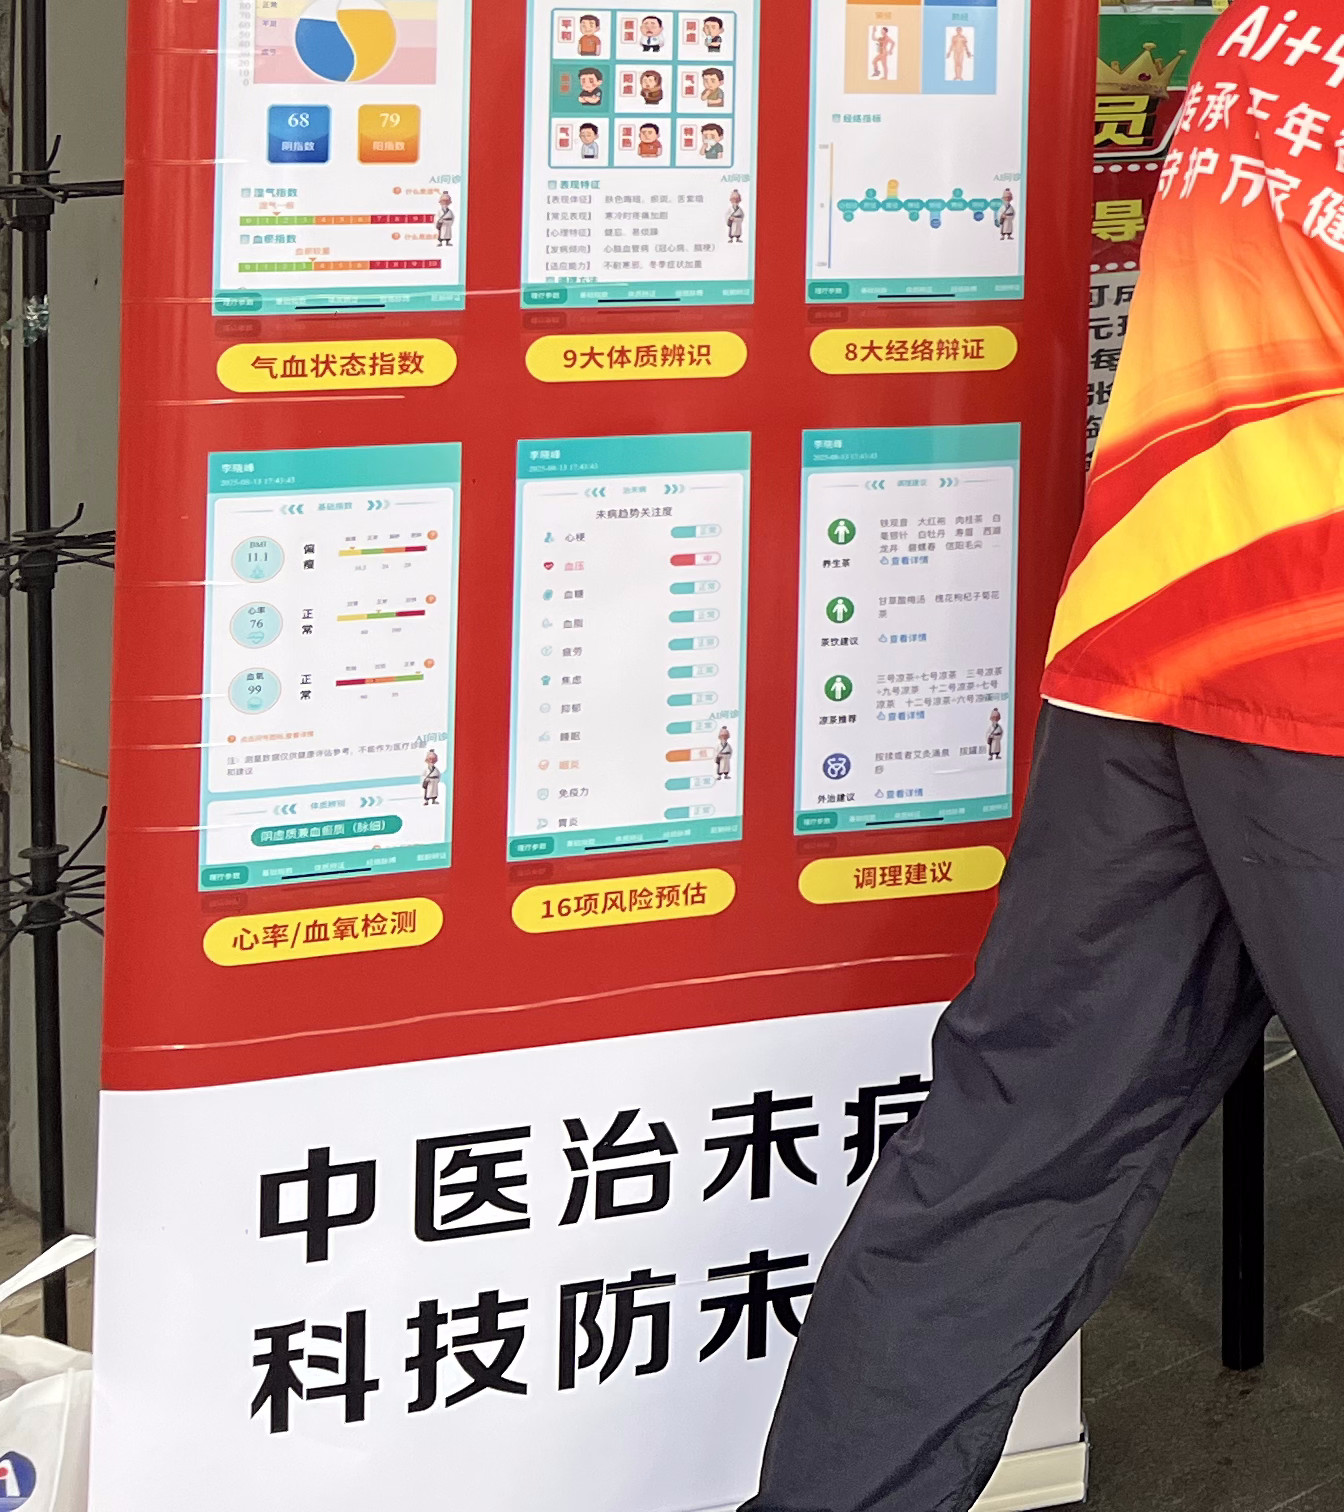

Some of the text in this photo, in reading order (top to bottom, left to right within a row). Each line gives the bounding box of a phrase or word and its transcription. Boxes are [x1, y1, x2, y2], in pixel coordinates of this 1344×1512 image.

[287, 112, 310, 128] 68
[379, 112, 401, 128] 79
[562, 343, 713, 370] 9大体质辨识
[844, 338, 986, 363] 8大经络辩证
[250, 350, 425, 380] 气血状态指数
[249, 619, 264, 629] 76
[853, 860, 953, 890] 调理建议
[541, 881, 708, 920] 16项风险预估
[231, 908, 418, 951] 心率/血氧检测
[249, 1248, 816, 1434] 科技防未
